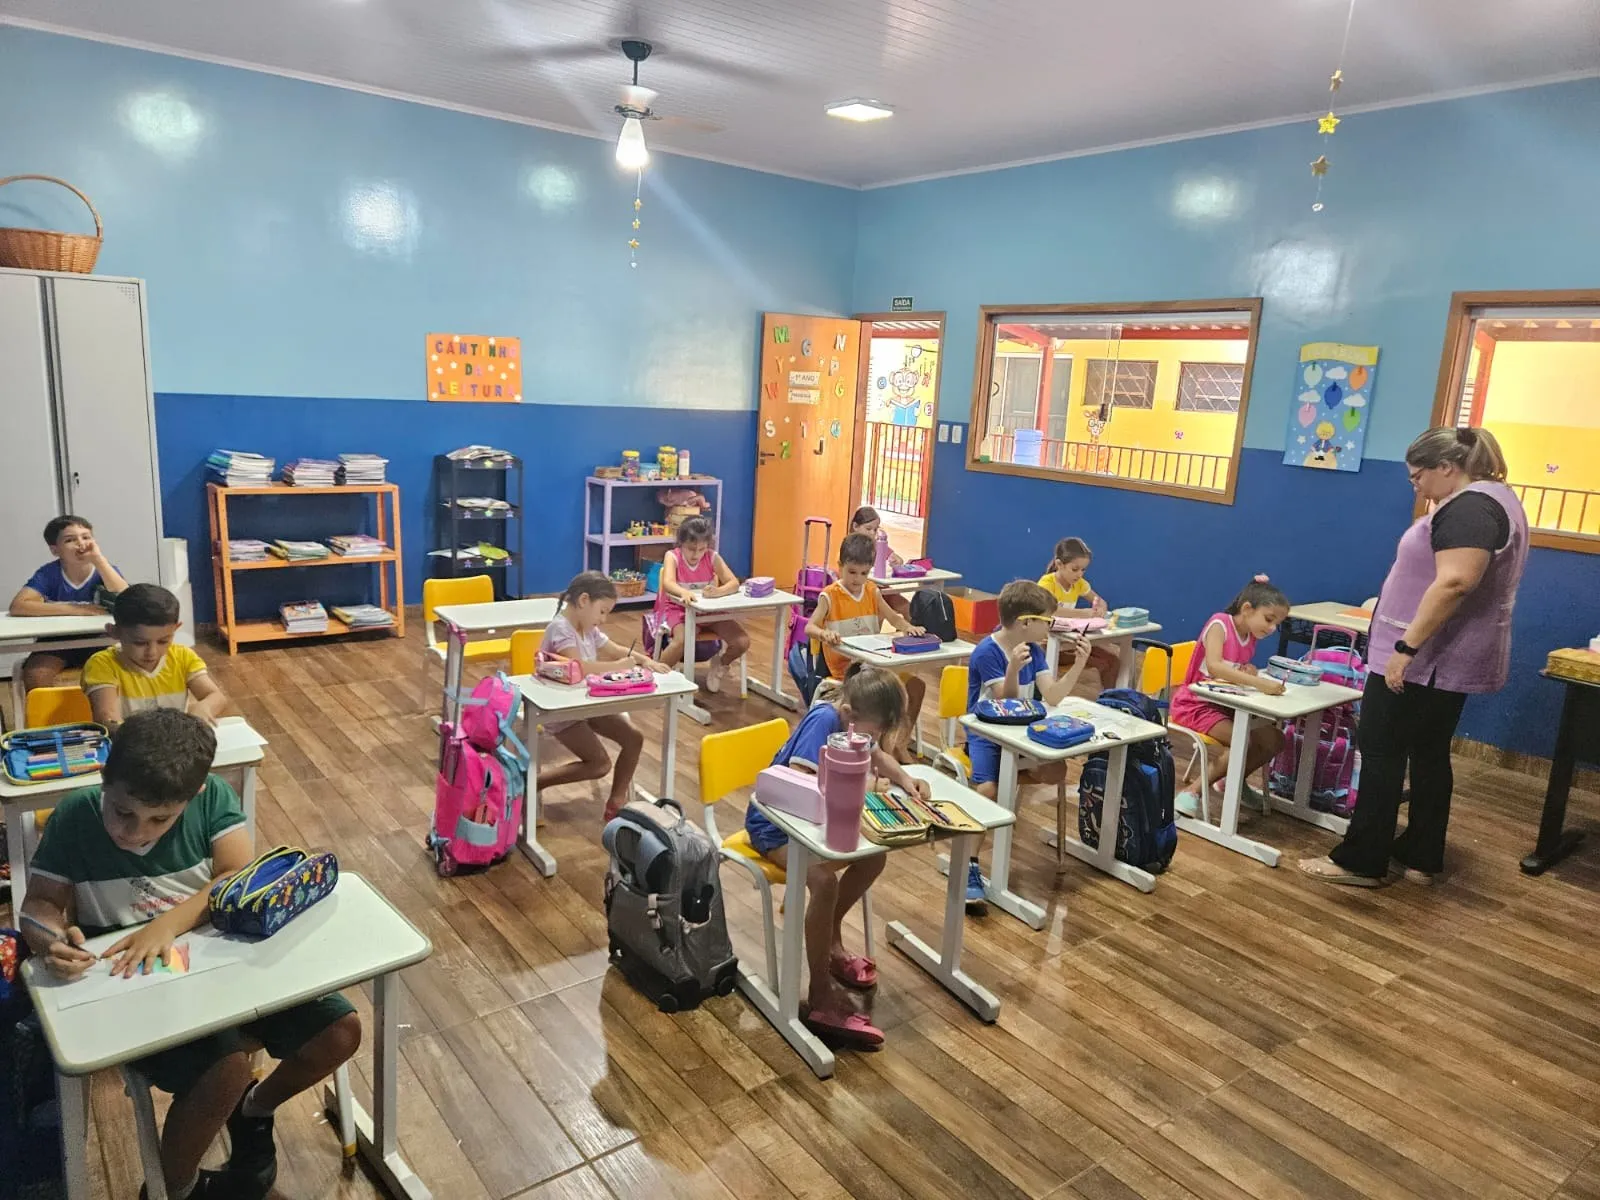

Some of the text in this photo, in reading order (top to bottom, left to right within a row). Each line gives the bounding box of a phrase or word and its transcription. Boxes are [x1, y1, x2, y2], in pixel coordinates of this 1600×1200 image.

[435, 341, 516, 358] CANTINHO
[835, 334, 847, 351] N
[465, 363, 482, 376] DA
[438, 381, 514, 397] LEITURA
[764, 419, 776, 438] S
